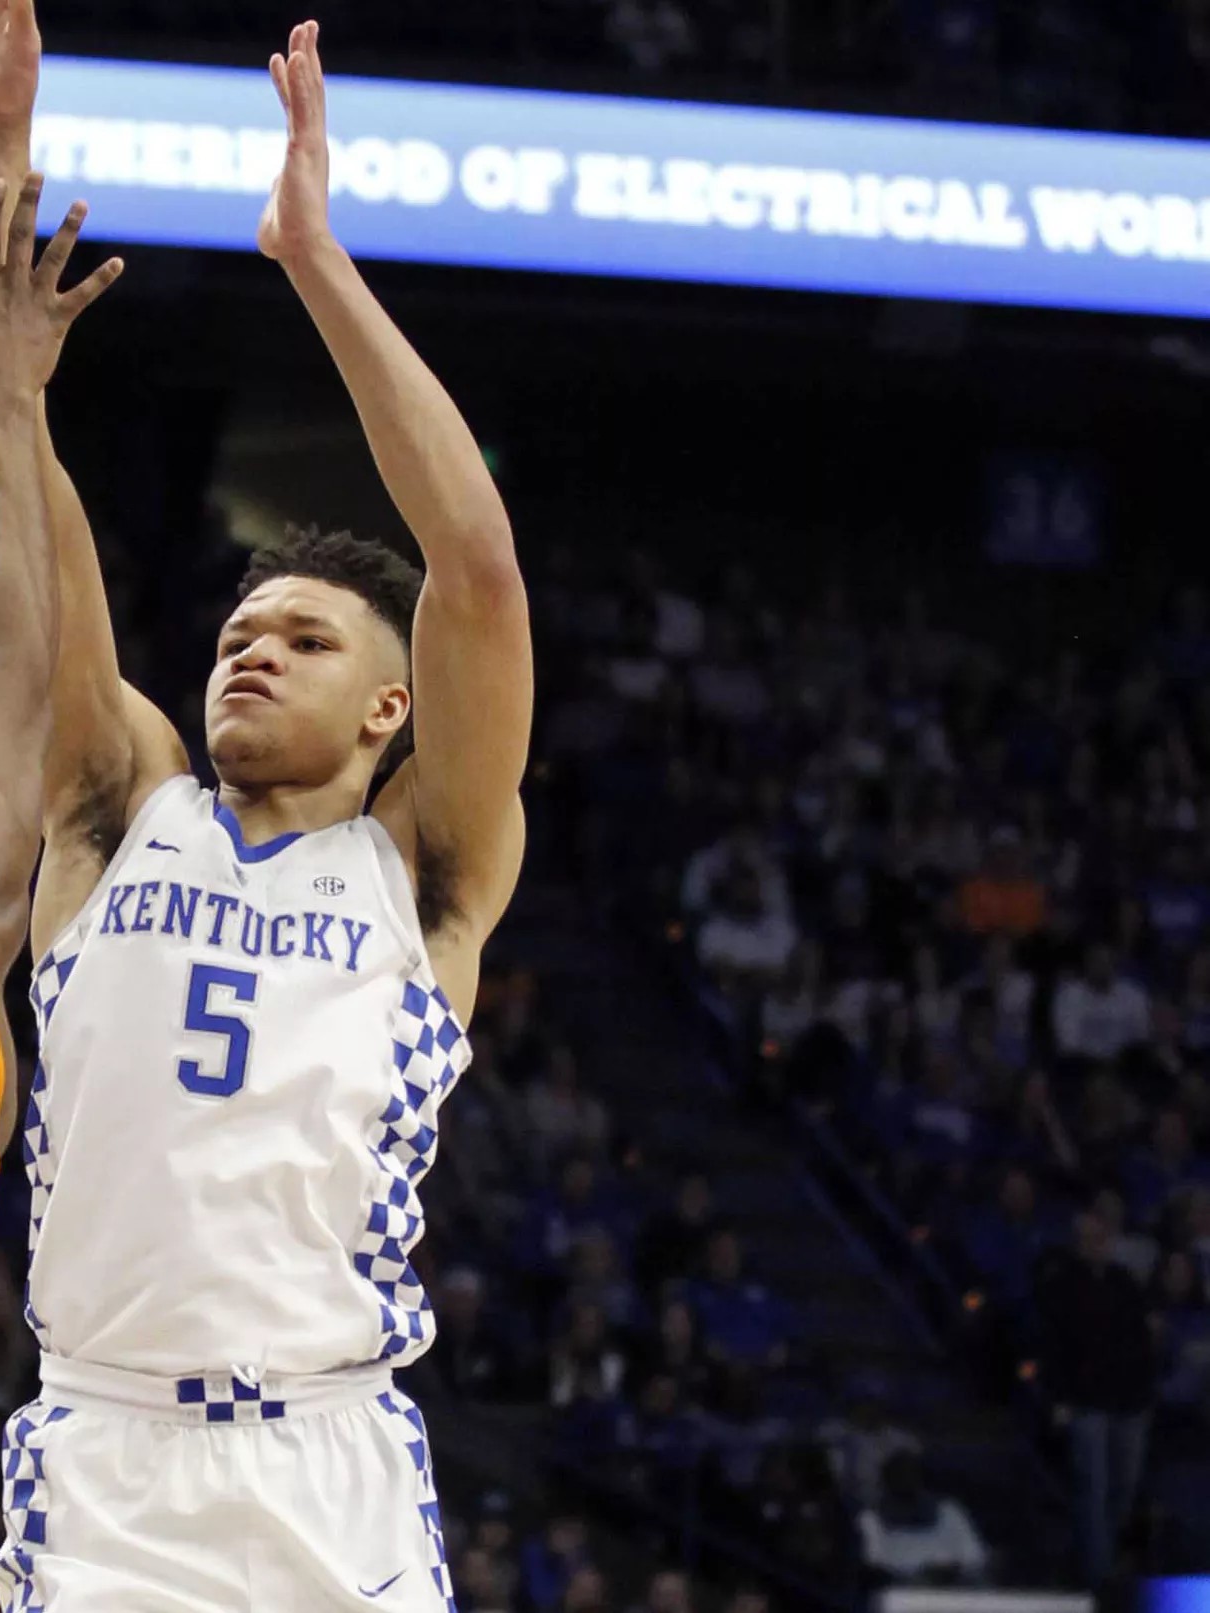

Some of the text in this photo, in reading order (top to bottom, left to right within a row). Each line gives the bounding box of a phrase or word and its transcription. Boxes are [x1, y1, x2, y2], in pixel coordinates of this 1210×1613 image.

[460, 144, 567, 213] OF
[573, 152, 1028, 249] ELECTRICAL
[99, 881, 372, 972] KENTUCKY
[313, 876, 346, 896] SEC
[177, 961, 259, 1099] 5
